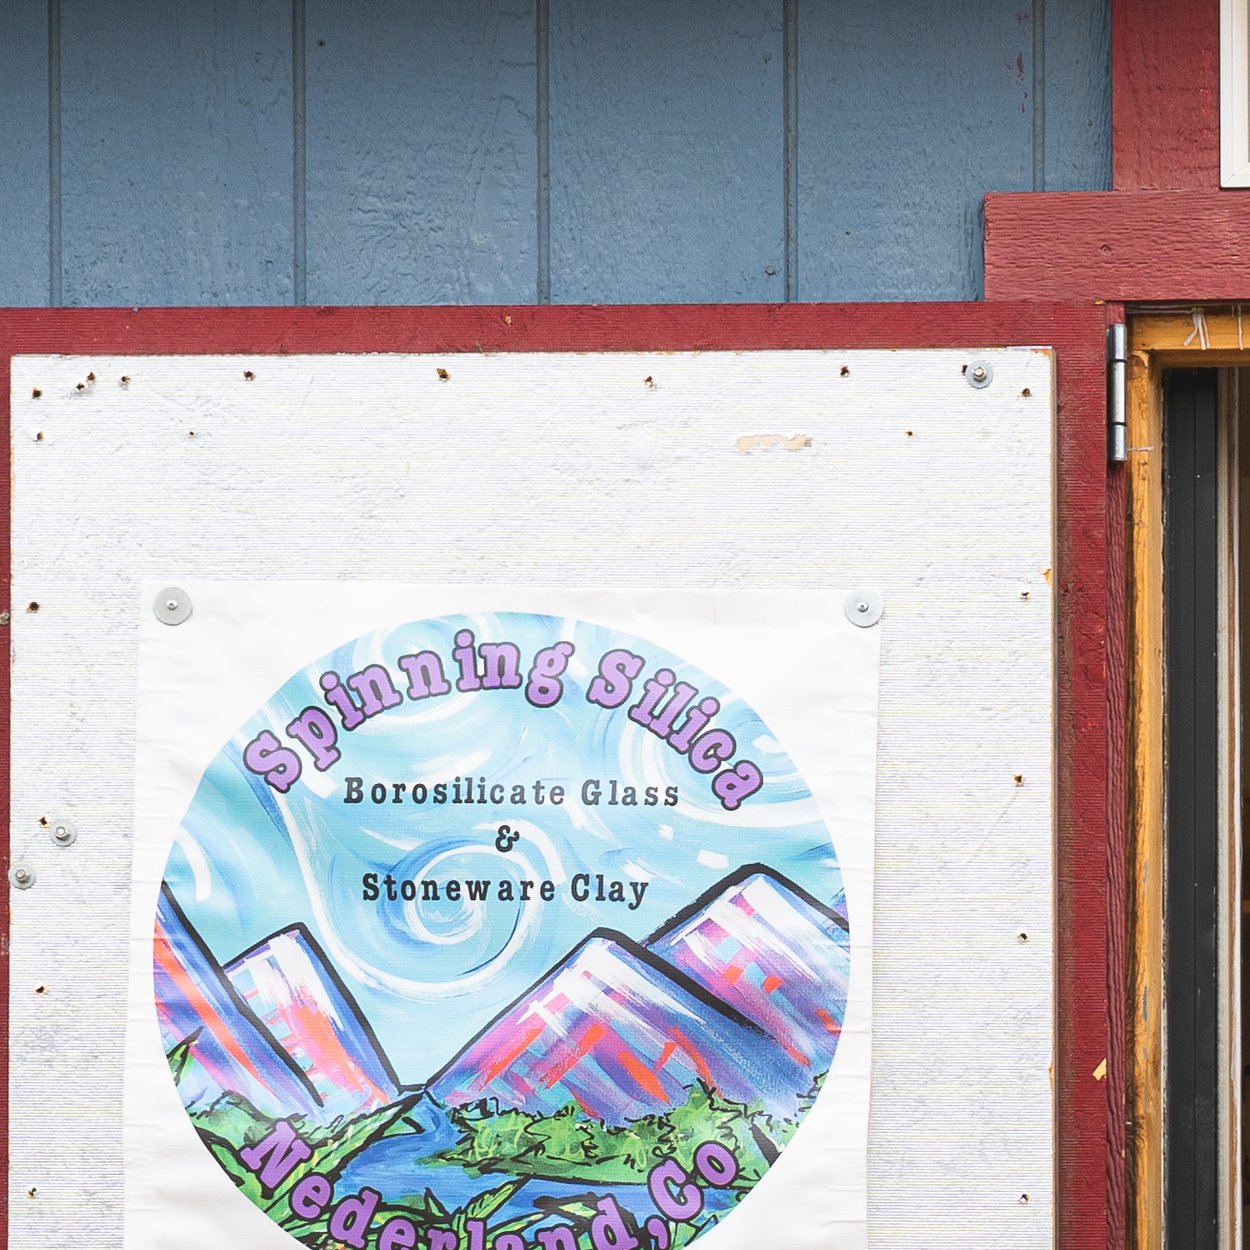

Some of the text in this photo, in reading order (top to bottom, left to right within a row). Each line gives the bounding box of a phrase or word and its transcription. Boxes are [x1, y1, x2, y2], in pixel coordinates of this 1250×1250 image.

[243, 628, 764, 811] Spinning Silica
[343, 774, 680, 808] Borosilicate Glass
[495, 825, 520, 853] &
[362, 873, 649, 908] Stoneware Clay
